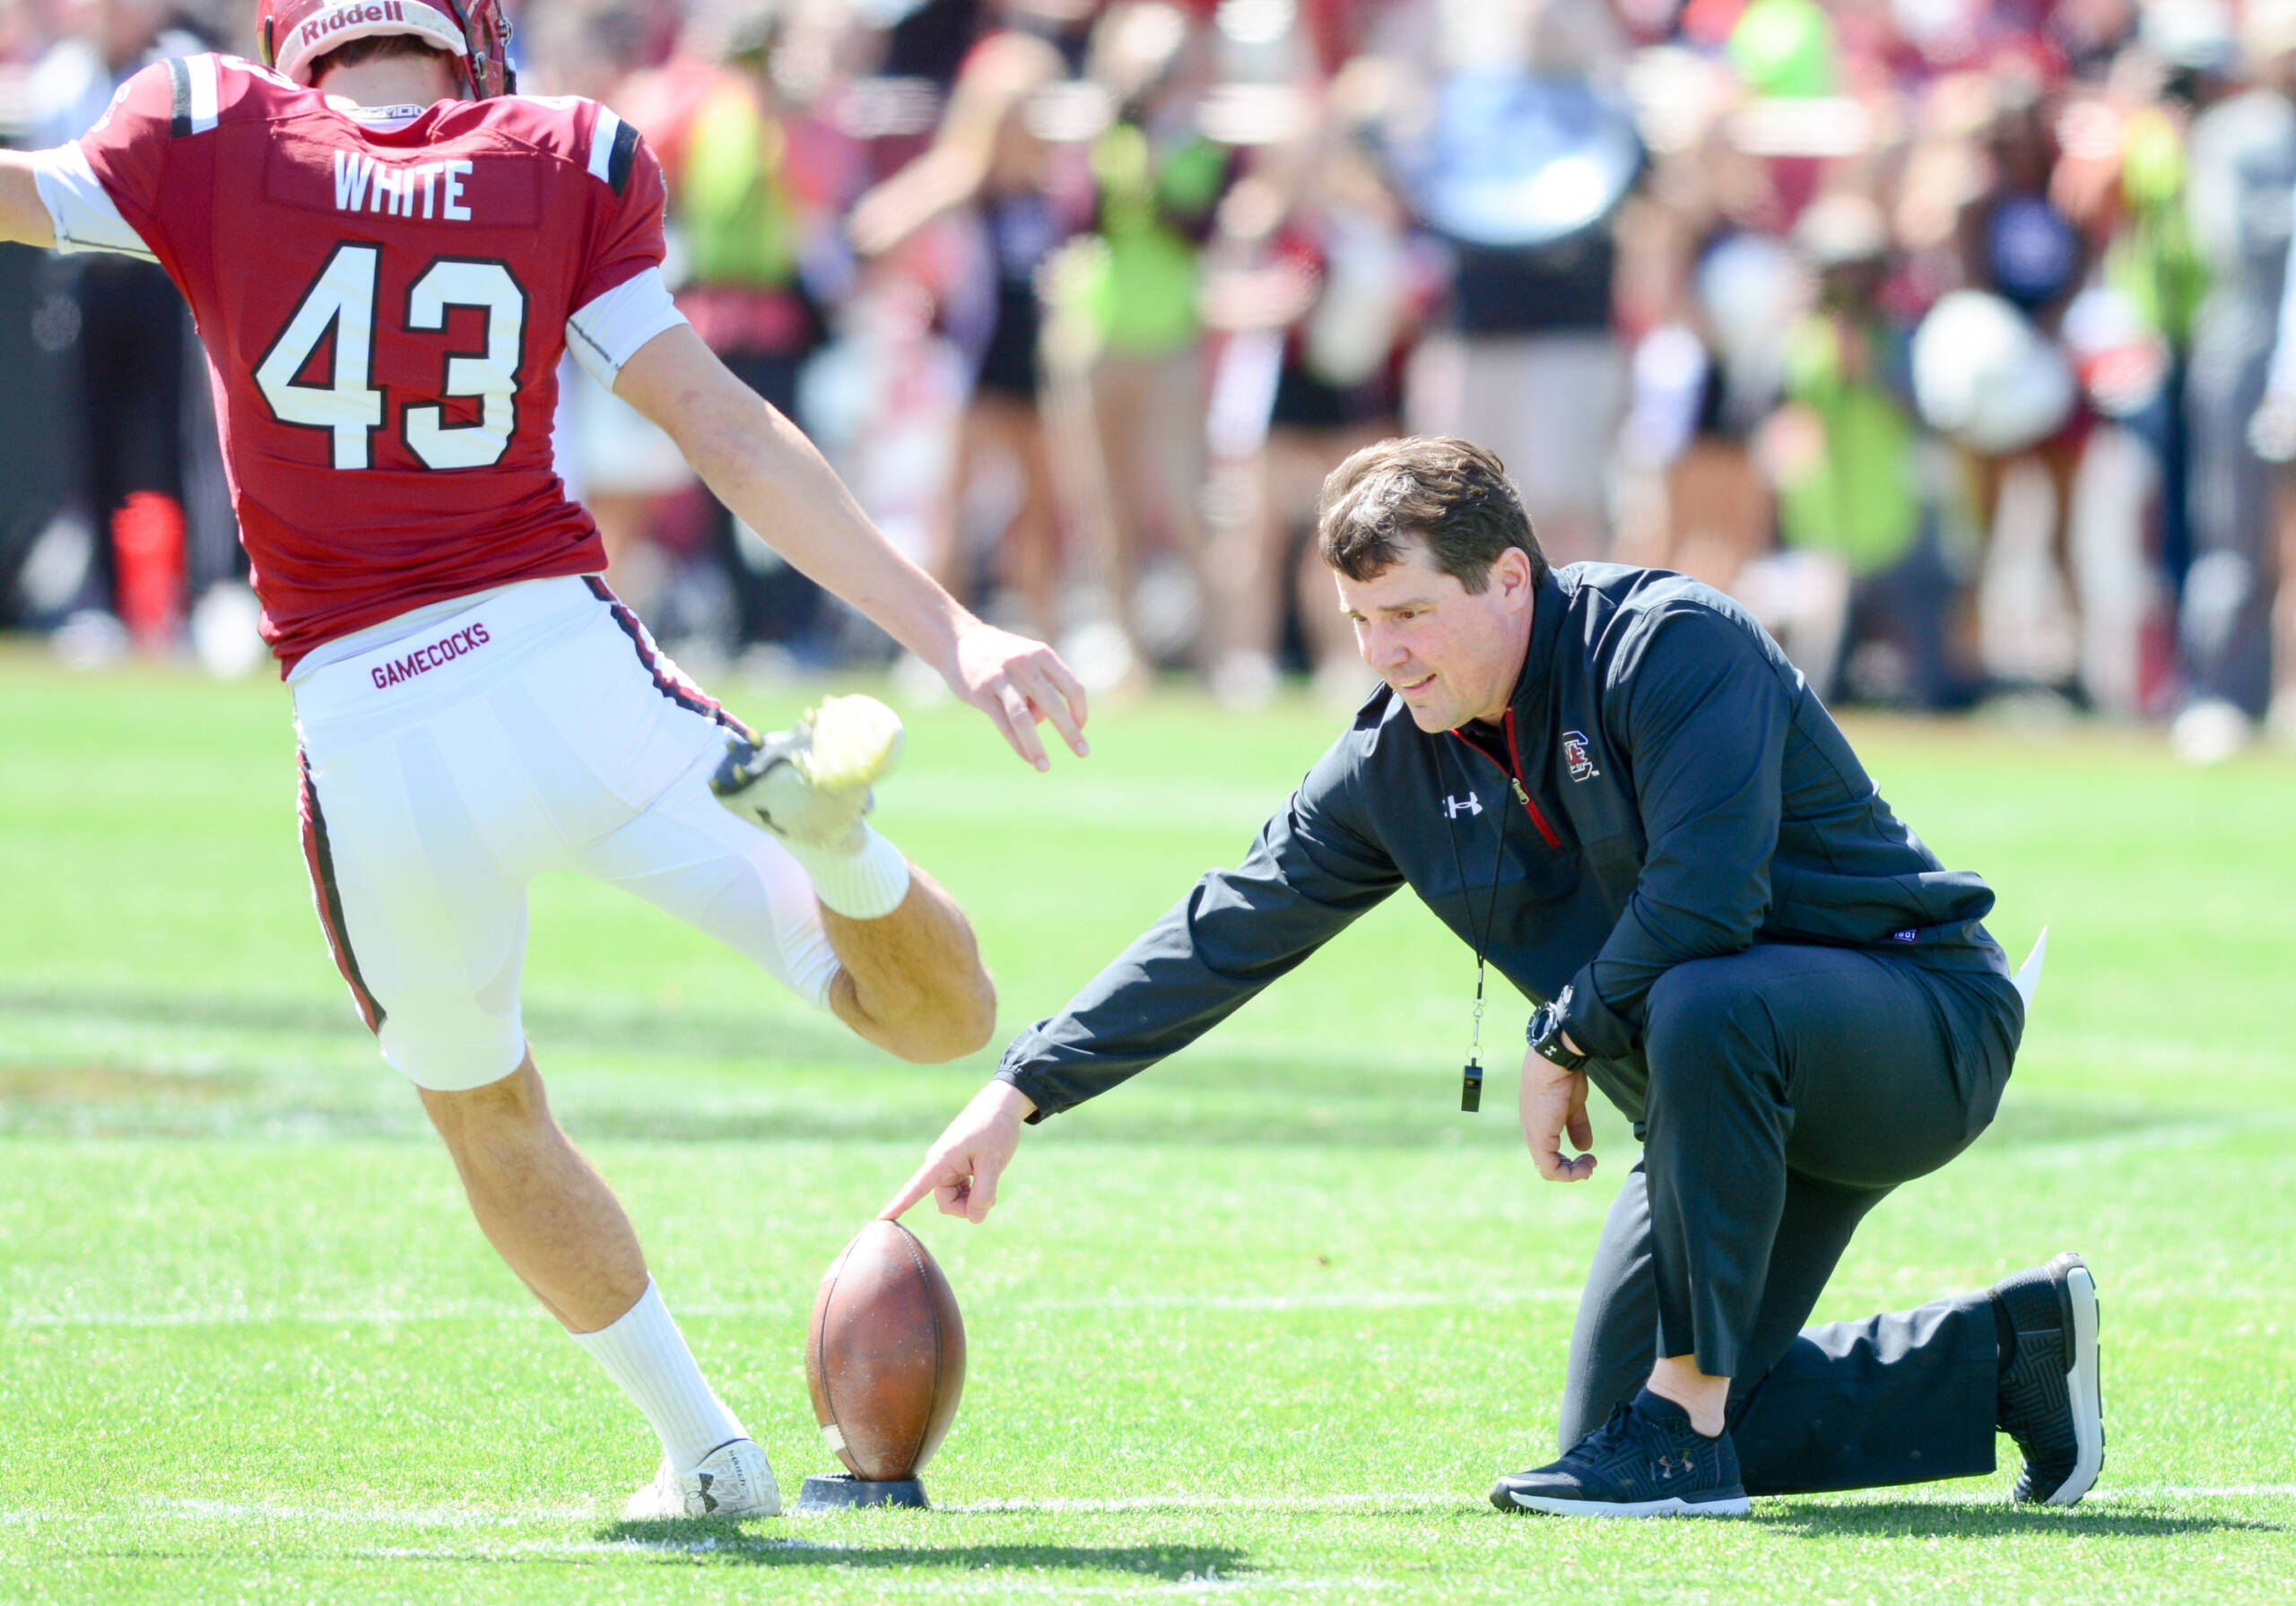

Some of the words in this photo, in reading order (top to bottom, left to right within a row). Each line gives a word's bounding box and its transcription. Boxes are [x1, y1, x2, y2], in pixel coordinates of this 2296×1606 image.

[301, 1, 404, 47] Riddell
[334, 149, 474, 221] WHITE
[251, 239, 529, 471] 43
[371, 622, 491, 689] GAMECOCKS
